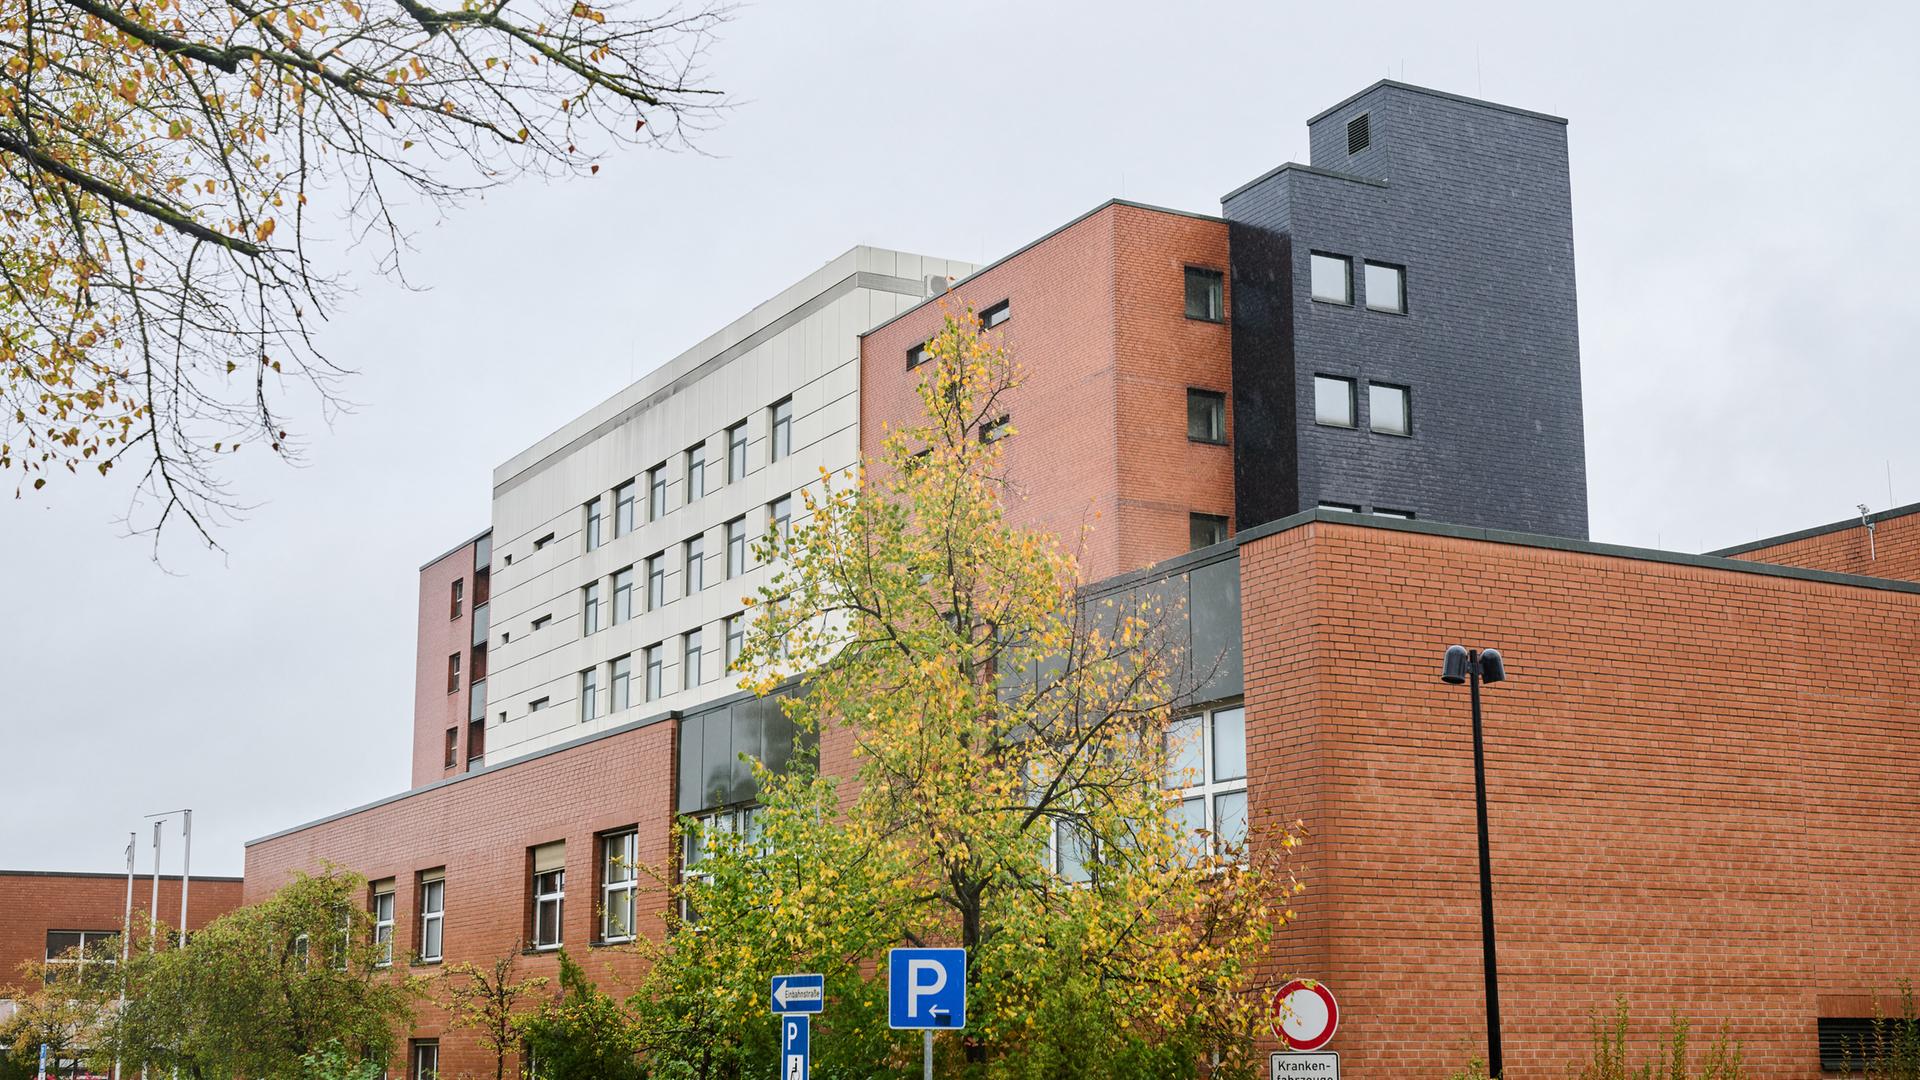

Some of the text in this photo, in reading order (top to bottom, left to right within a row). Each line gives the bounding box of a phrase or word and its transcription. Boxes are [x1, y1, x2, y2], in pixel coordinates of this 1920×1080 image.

[785, 989, 820, 999] Einbahnstraße
[908, 959, 947, 1017] P
[787, 1022, 798, 1050] P
[1278, 1060, 1331, 1071] Kranken-
